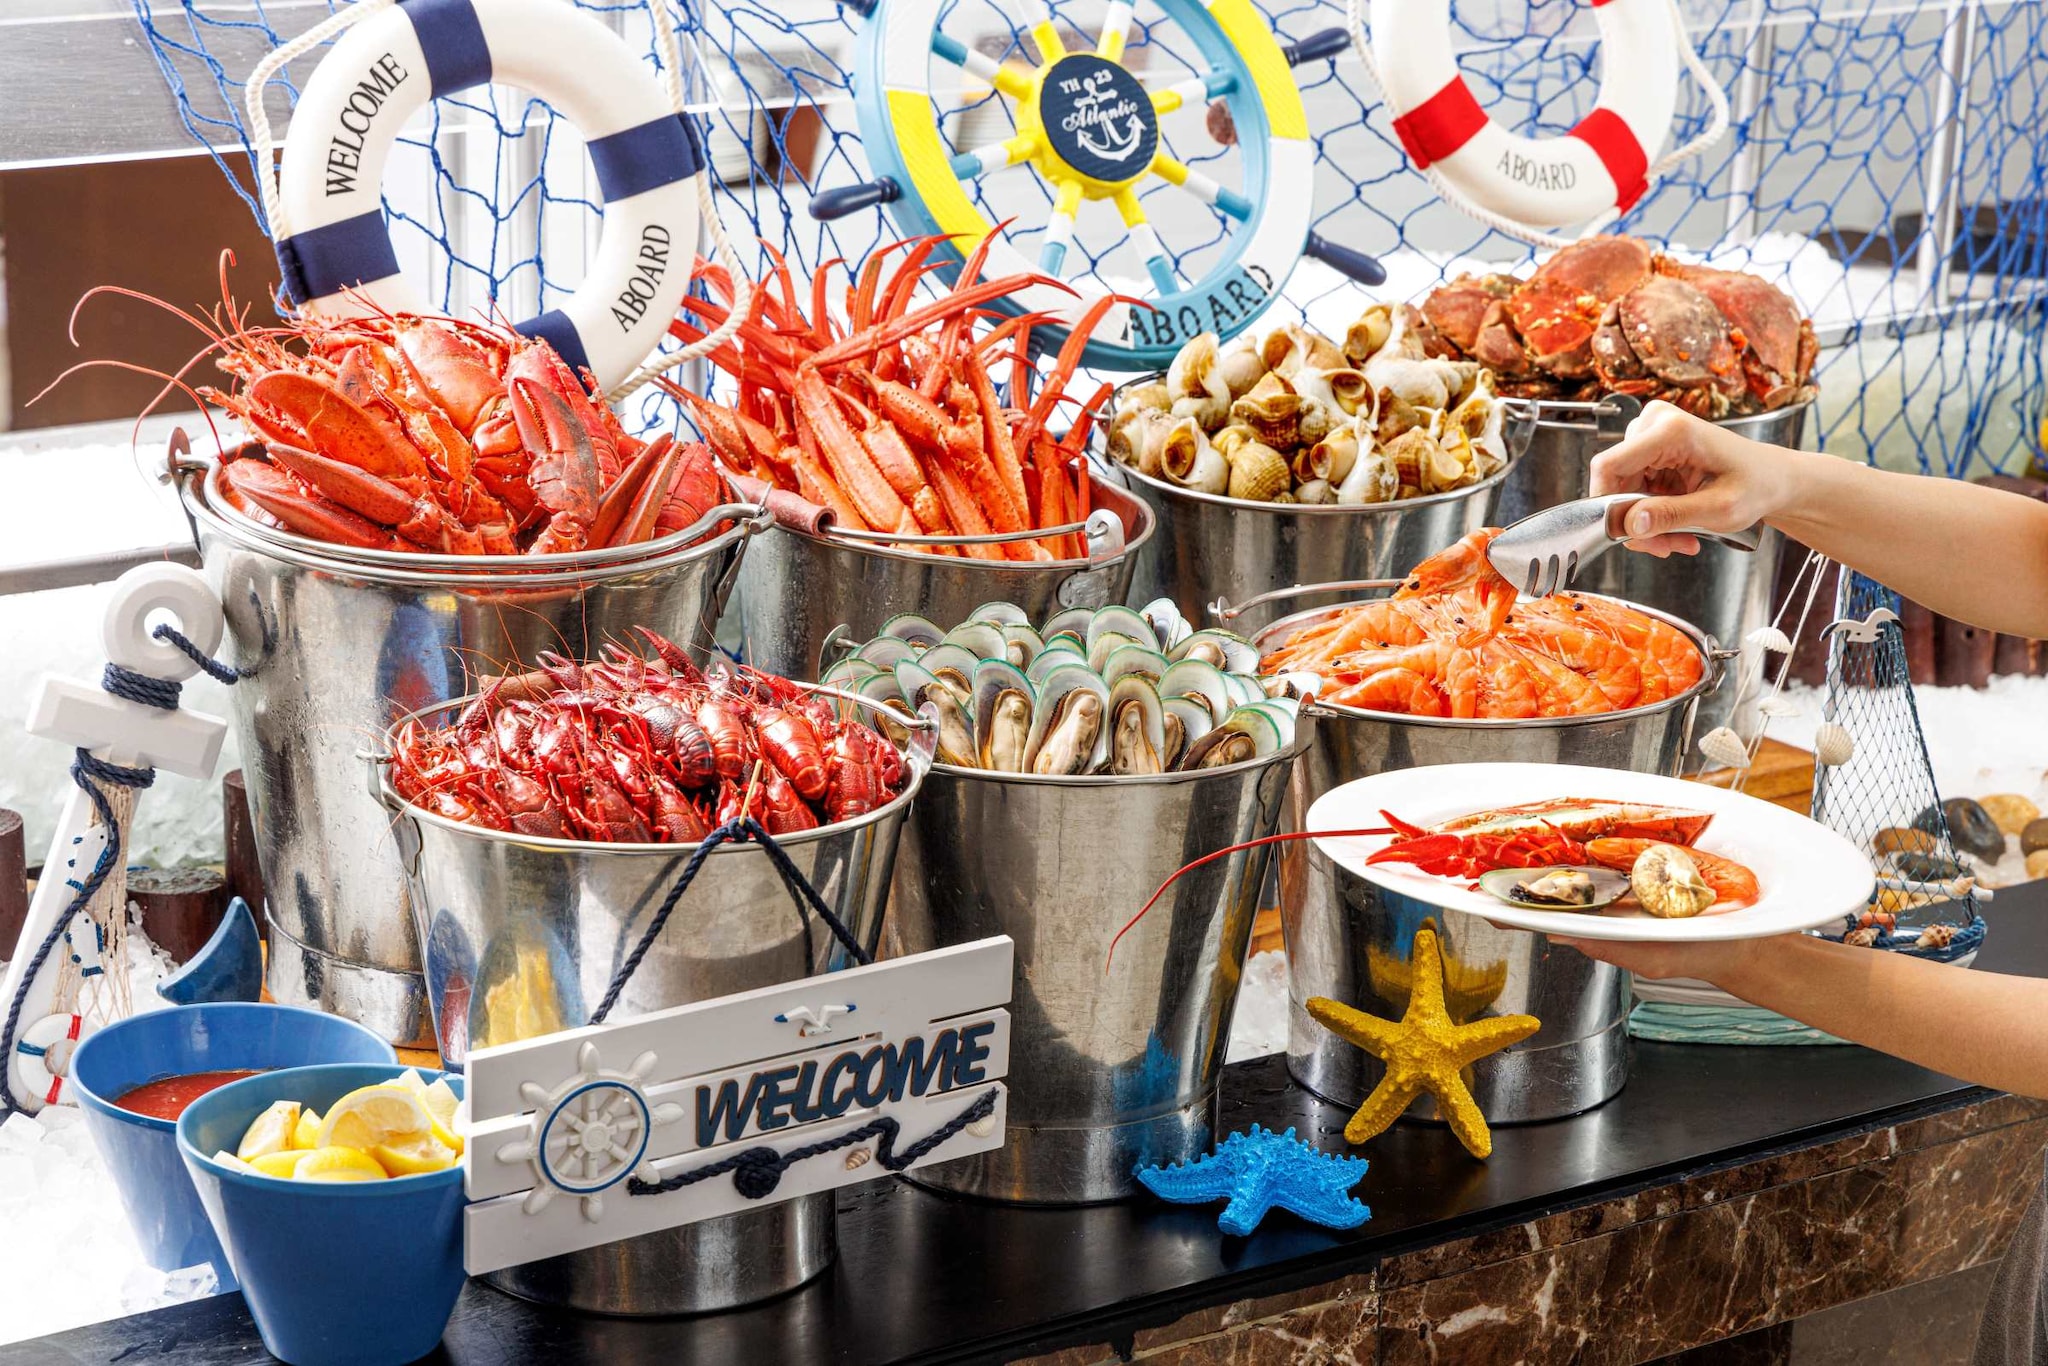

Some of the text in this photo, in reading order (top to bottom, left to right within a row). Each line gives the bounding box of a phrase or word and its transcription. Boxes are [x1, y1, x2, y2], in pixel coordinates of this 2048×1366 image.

[1062, 98, 1138, 132] Atlantic
[1093, 69, 1113, 85] 23
[326, 52, 409, 197] WELCOME
[1496, 149, 1576, 191] ABOARD
[611, 224, 671, 333] ABOARD
[1121, 265, 1273, 346] ABOARD
[695, 1020, 996, 1148] WELCOME
